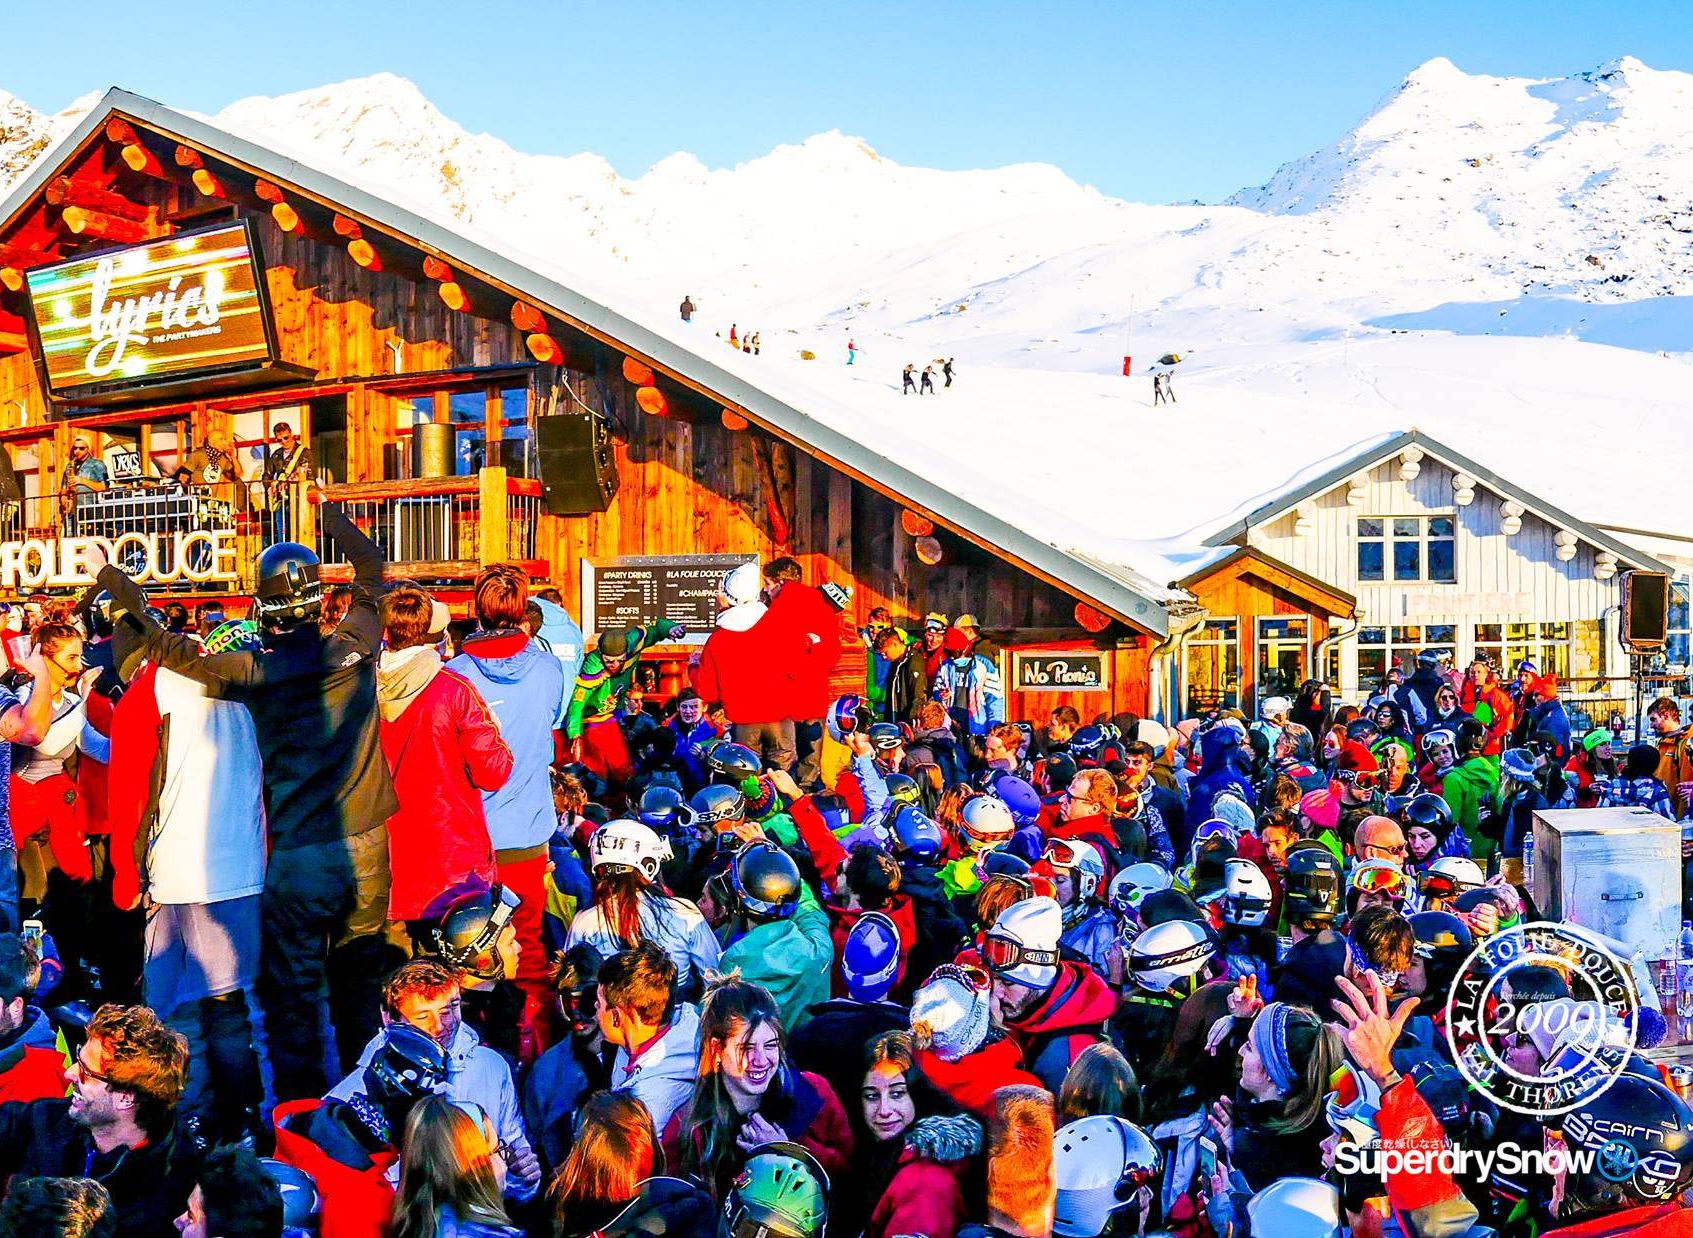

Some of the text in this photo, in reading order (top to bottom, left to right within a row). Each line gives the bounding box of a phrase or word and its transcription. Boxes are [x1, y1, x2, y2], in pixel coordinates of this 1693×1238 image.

[627, 571, 653, 579] DRINKS
[679, 570, 700, 578] FOLIE
[1024, 661, 1049, 684] No
